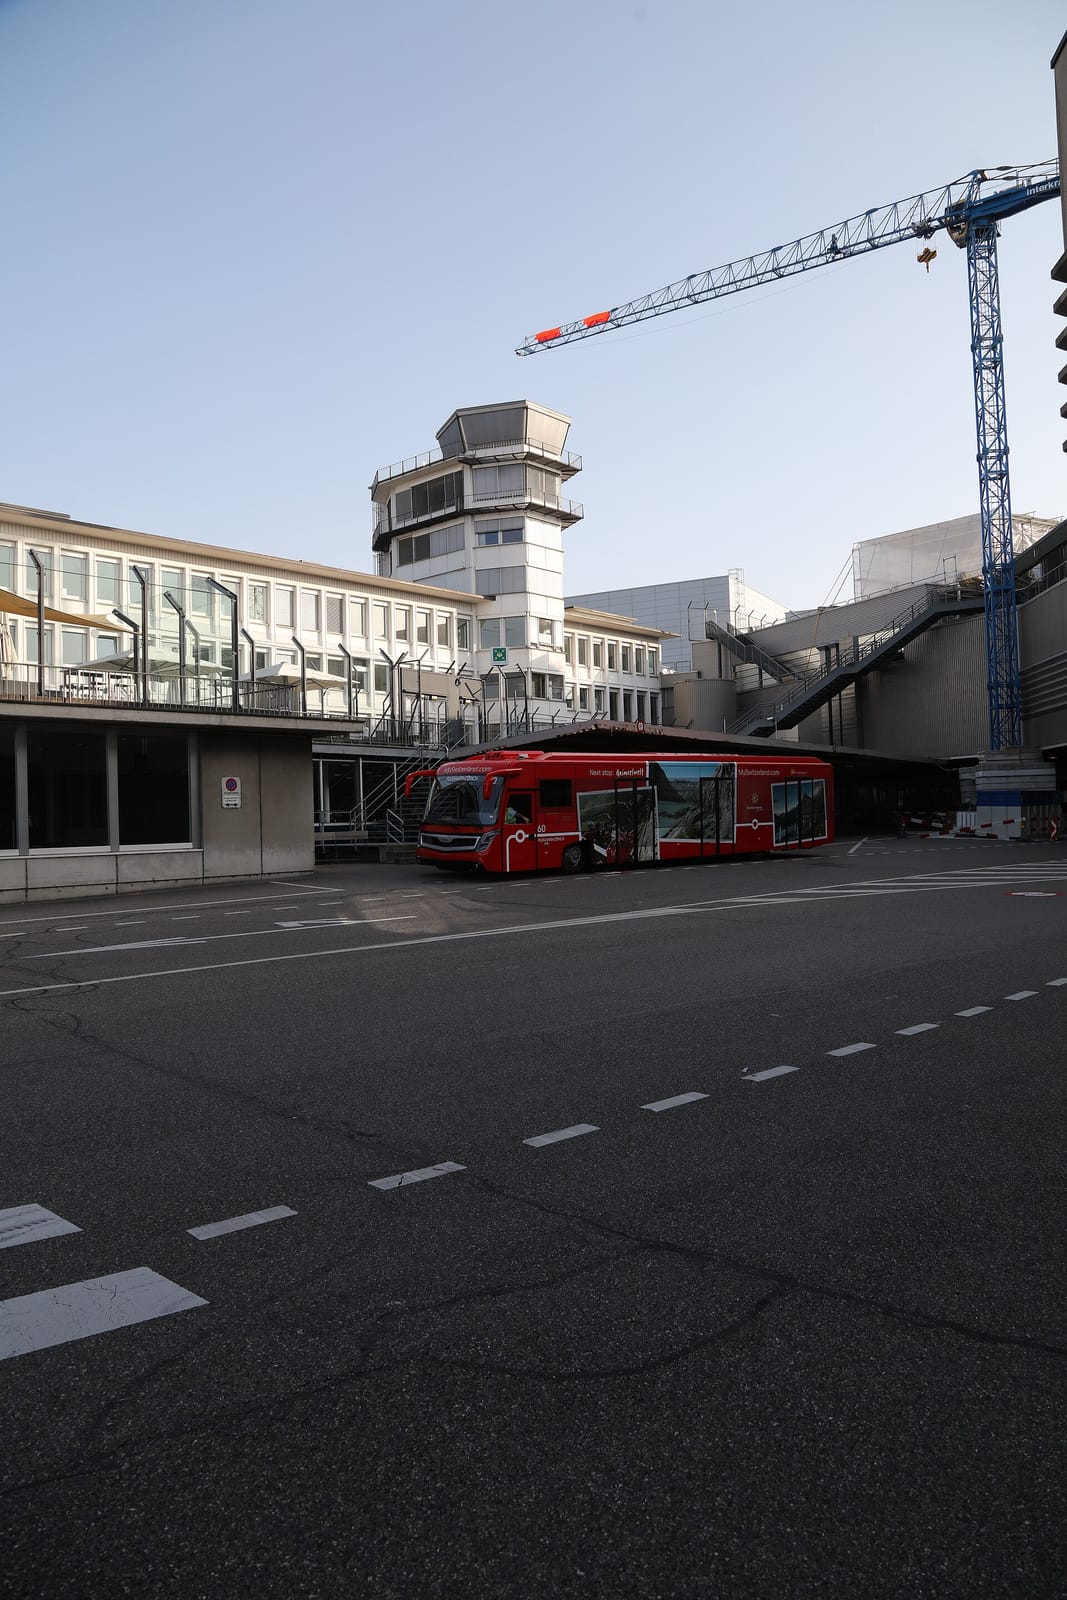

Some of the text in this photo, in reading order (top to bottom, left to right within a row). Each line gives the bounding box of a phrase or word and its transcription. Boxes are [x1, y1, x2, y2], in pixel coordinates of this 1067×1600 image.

[589, 768, 601, 776] Next
[738, 769, 780, 777] MySwitzerland.com
[537, 824, 546, 832] 60
